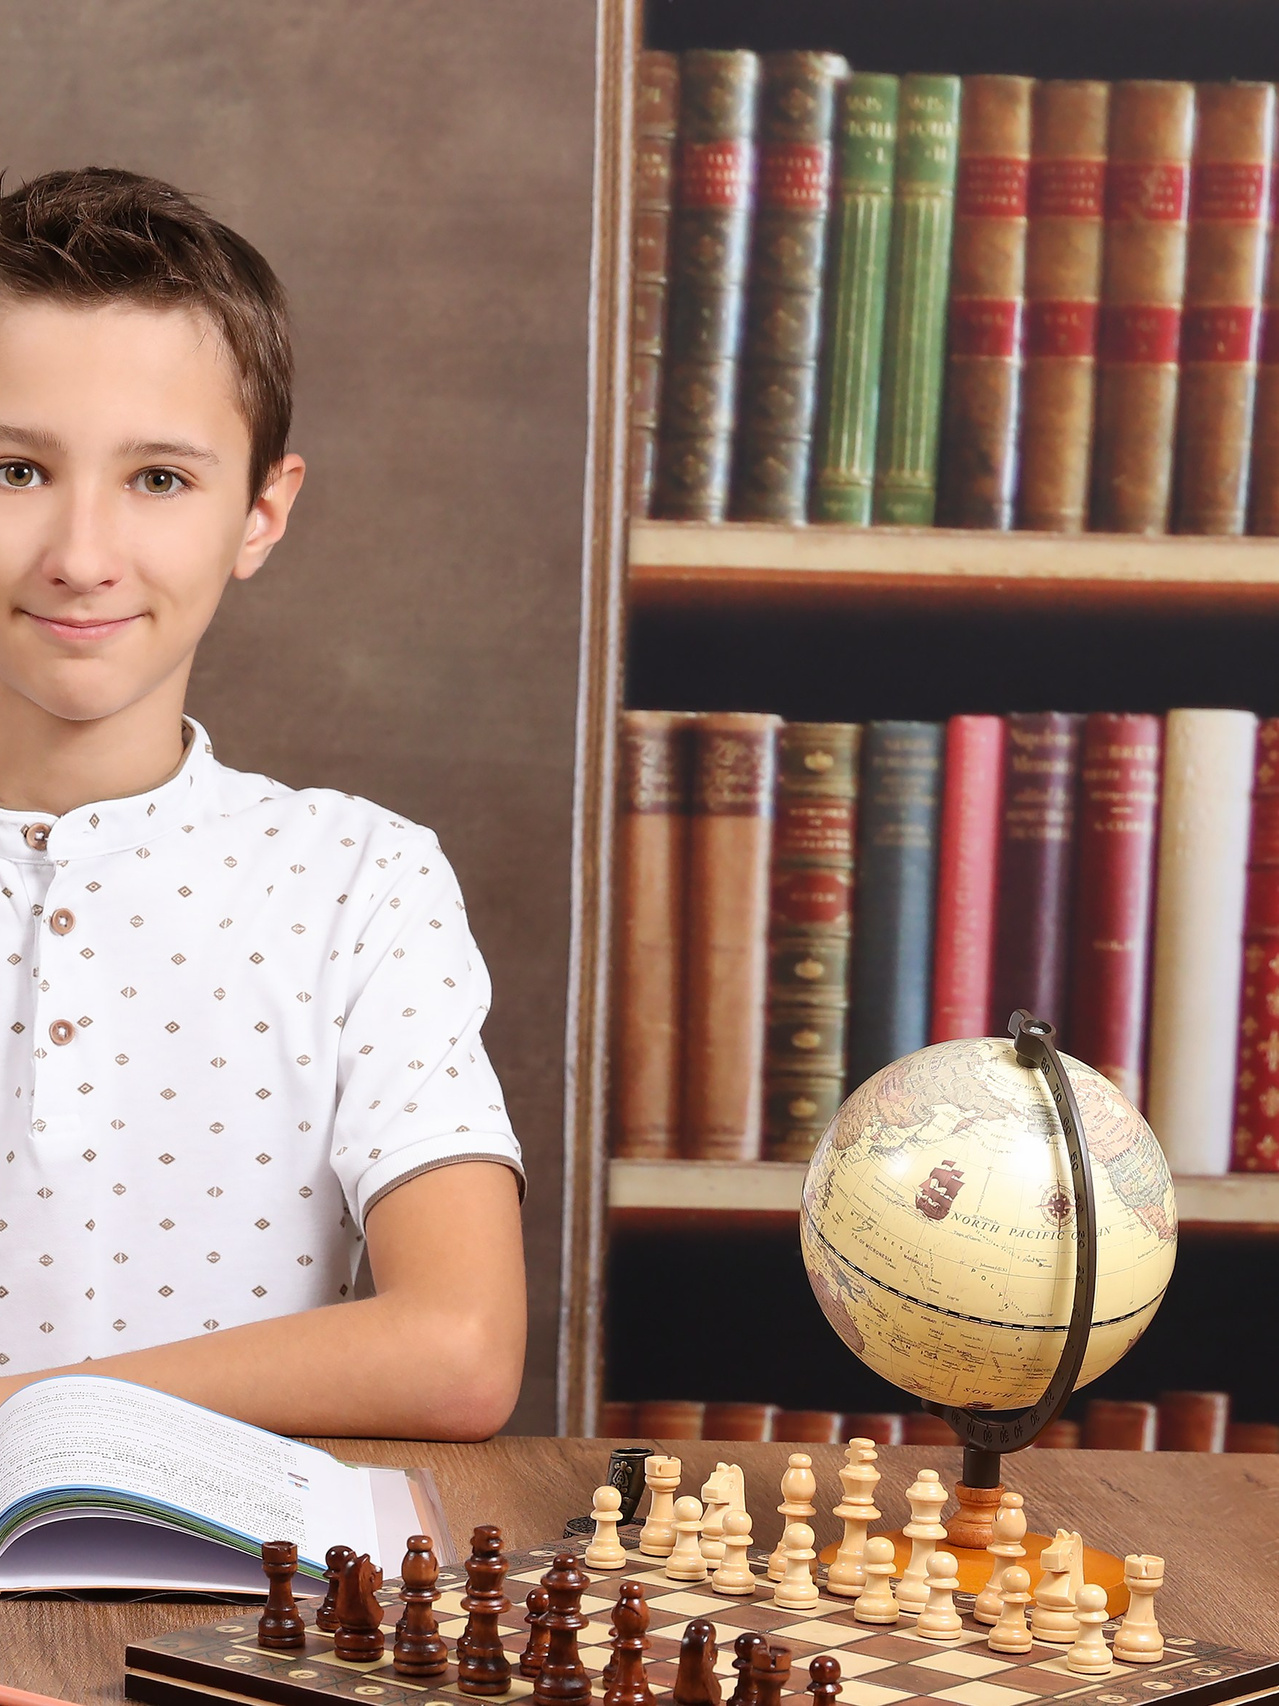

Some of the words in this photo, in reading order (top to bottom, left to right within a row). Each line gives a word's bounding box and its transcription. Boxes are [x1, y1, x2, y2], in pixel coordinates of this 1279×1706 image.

[1053, 1084, 1062, 1103] 70
[1109, 1148, 1131, 1164] NORTH
[950, 1212, 1001, 1233] NORTH
[1009, 1227, 1066, 1241] PACIFIC
[1071, 1226, 1112, 1241] OAN
